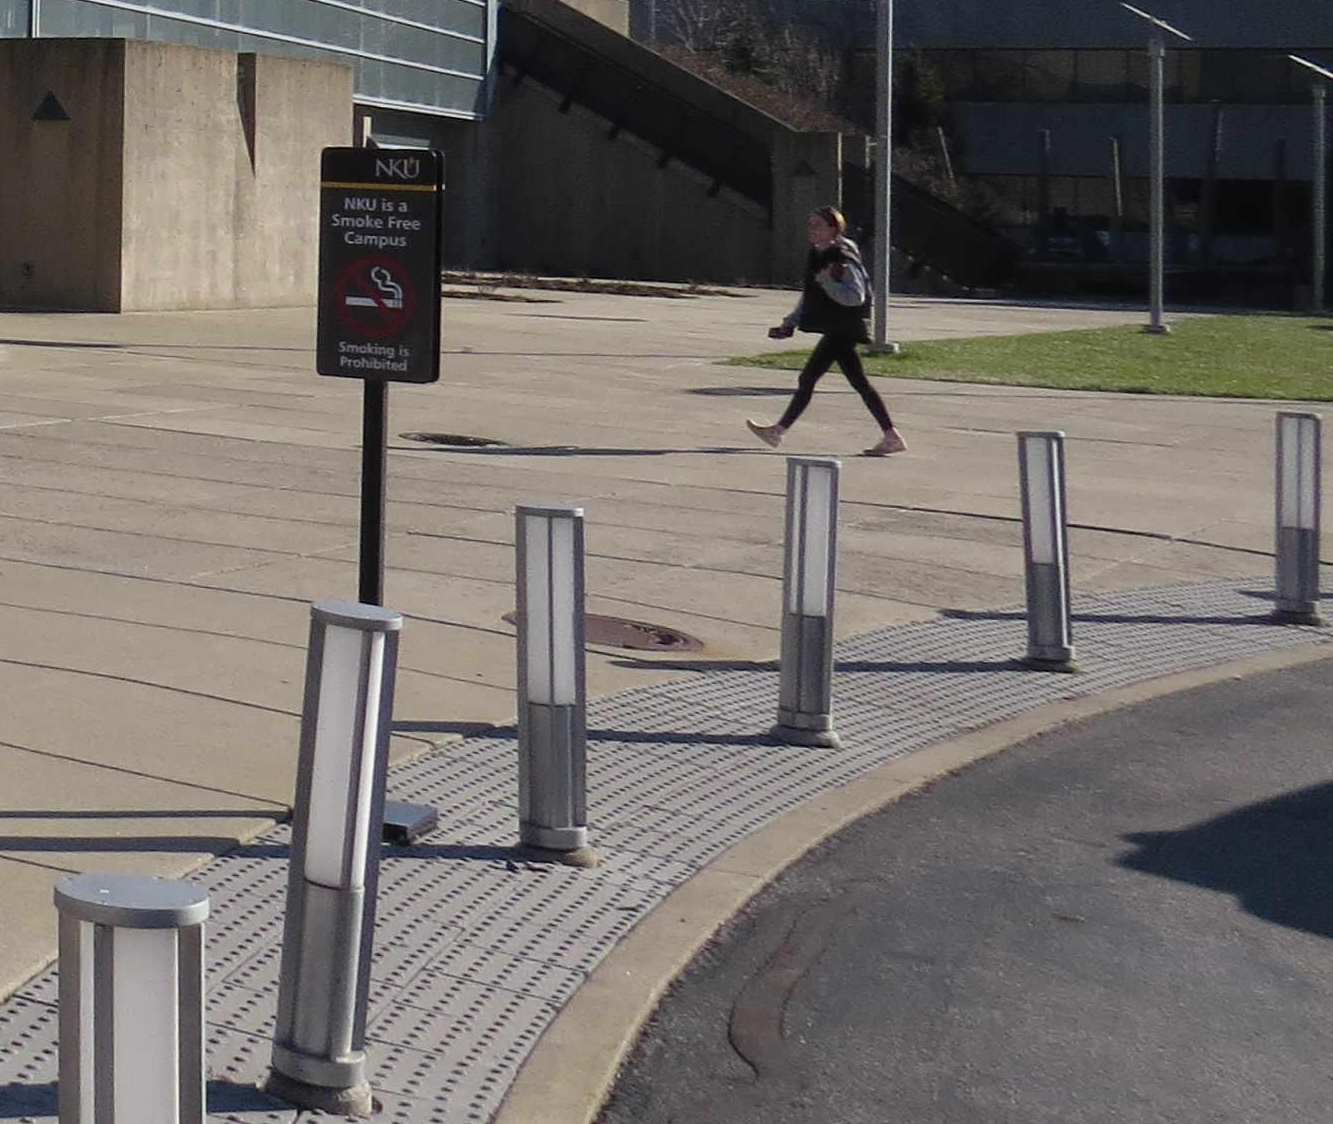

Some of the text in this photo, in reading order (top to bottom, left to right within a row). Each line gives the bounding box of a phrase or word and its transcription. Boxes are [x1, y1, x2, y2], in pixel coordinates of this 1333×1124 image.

[375, 158, 420, 180] NKU
[344, 197, 408, 213] NKU is a
[331, 213, 421, 231] Smoke Free
[344, 231, 407, 249] Campus
[338, 340, 410, 359] Smoking is
[339, 355, 408, 372] Prohibited
